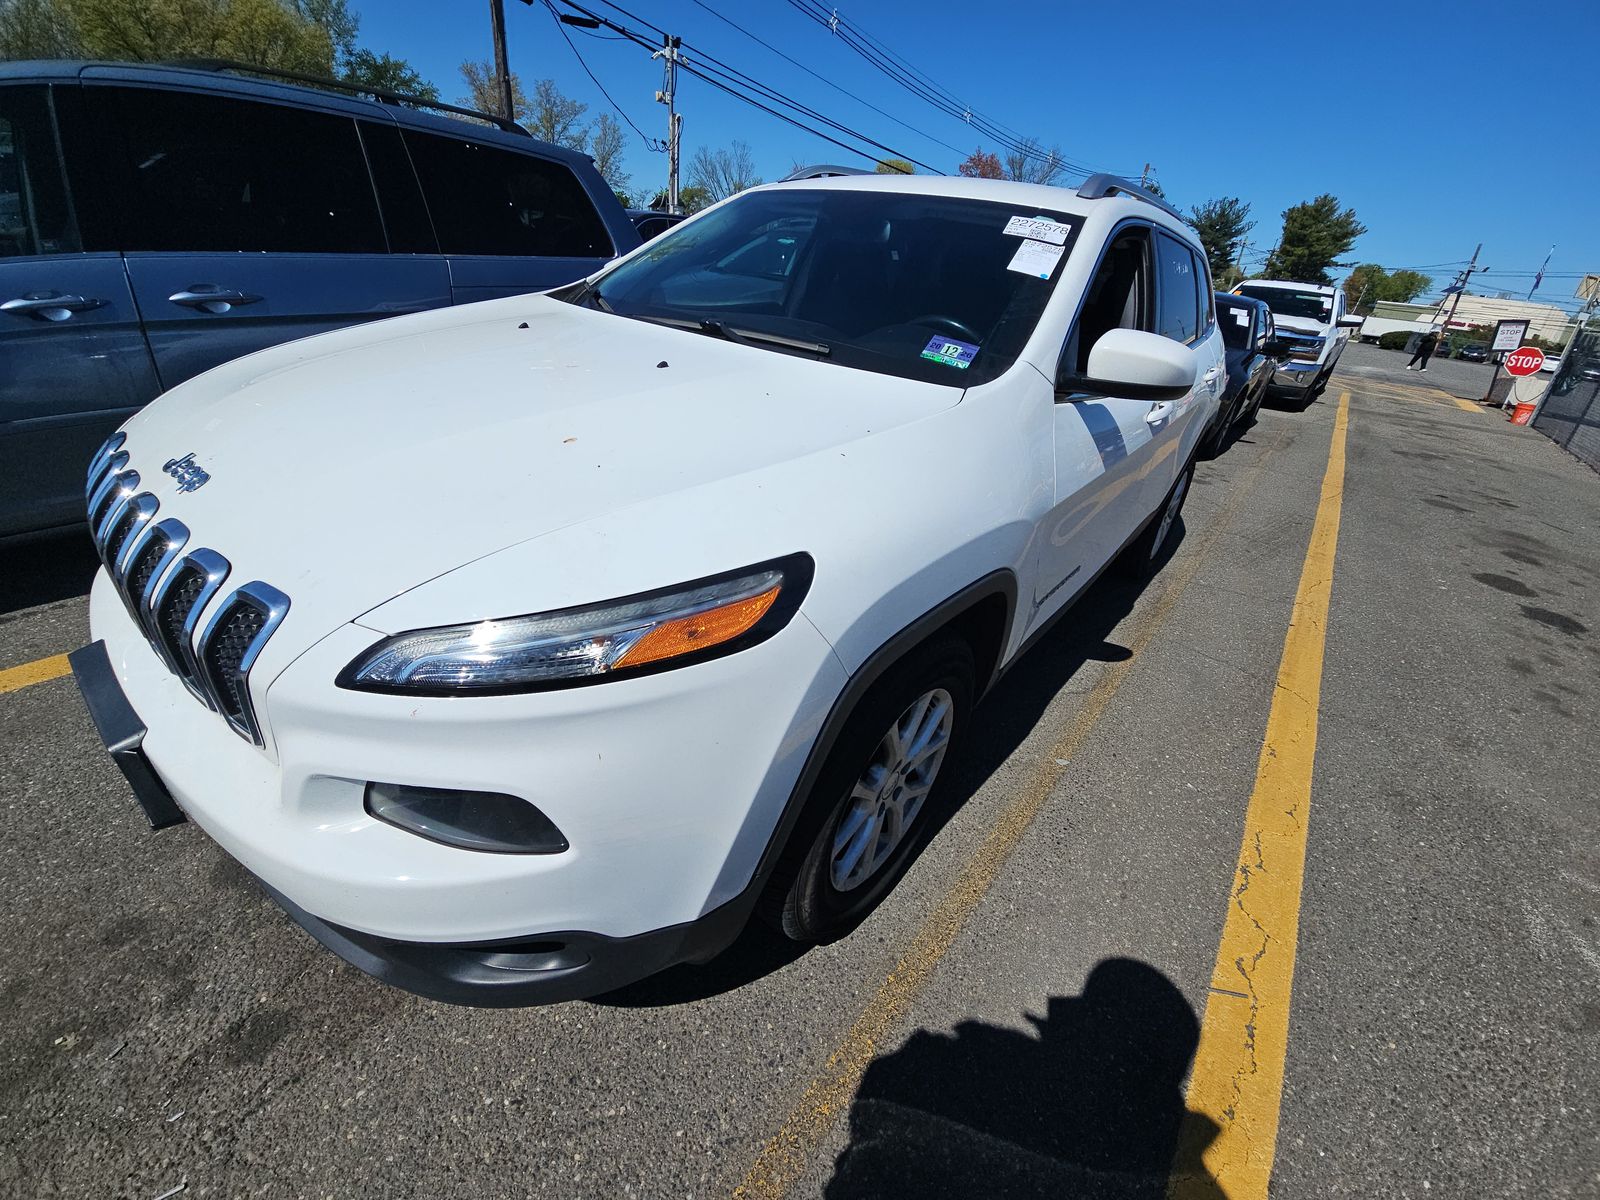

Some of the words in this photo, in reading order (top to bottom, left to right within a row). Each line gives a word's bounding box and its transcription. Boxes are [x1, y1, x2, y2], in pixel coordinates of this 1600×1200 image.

[1011, 218, 1068, 235] 2272578
[943, 345, 959, 356] 12
[1507, 355, 1542, 369] STOP
